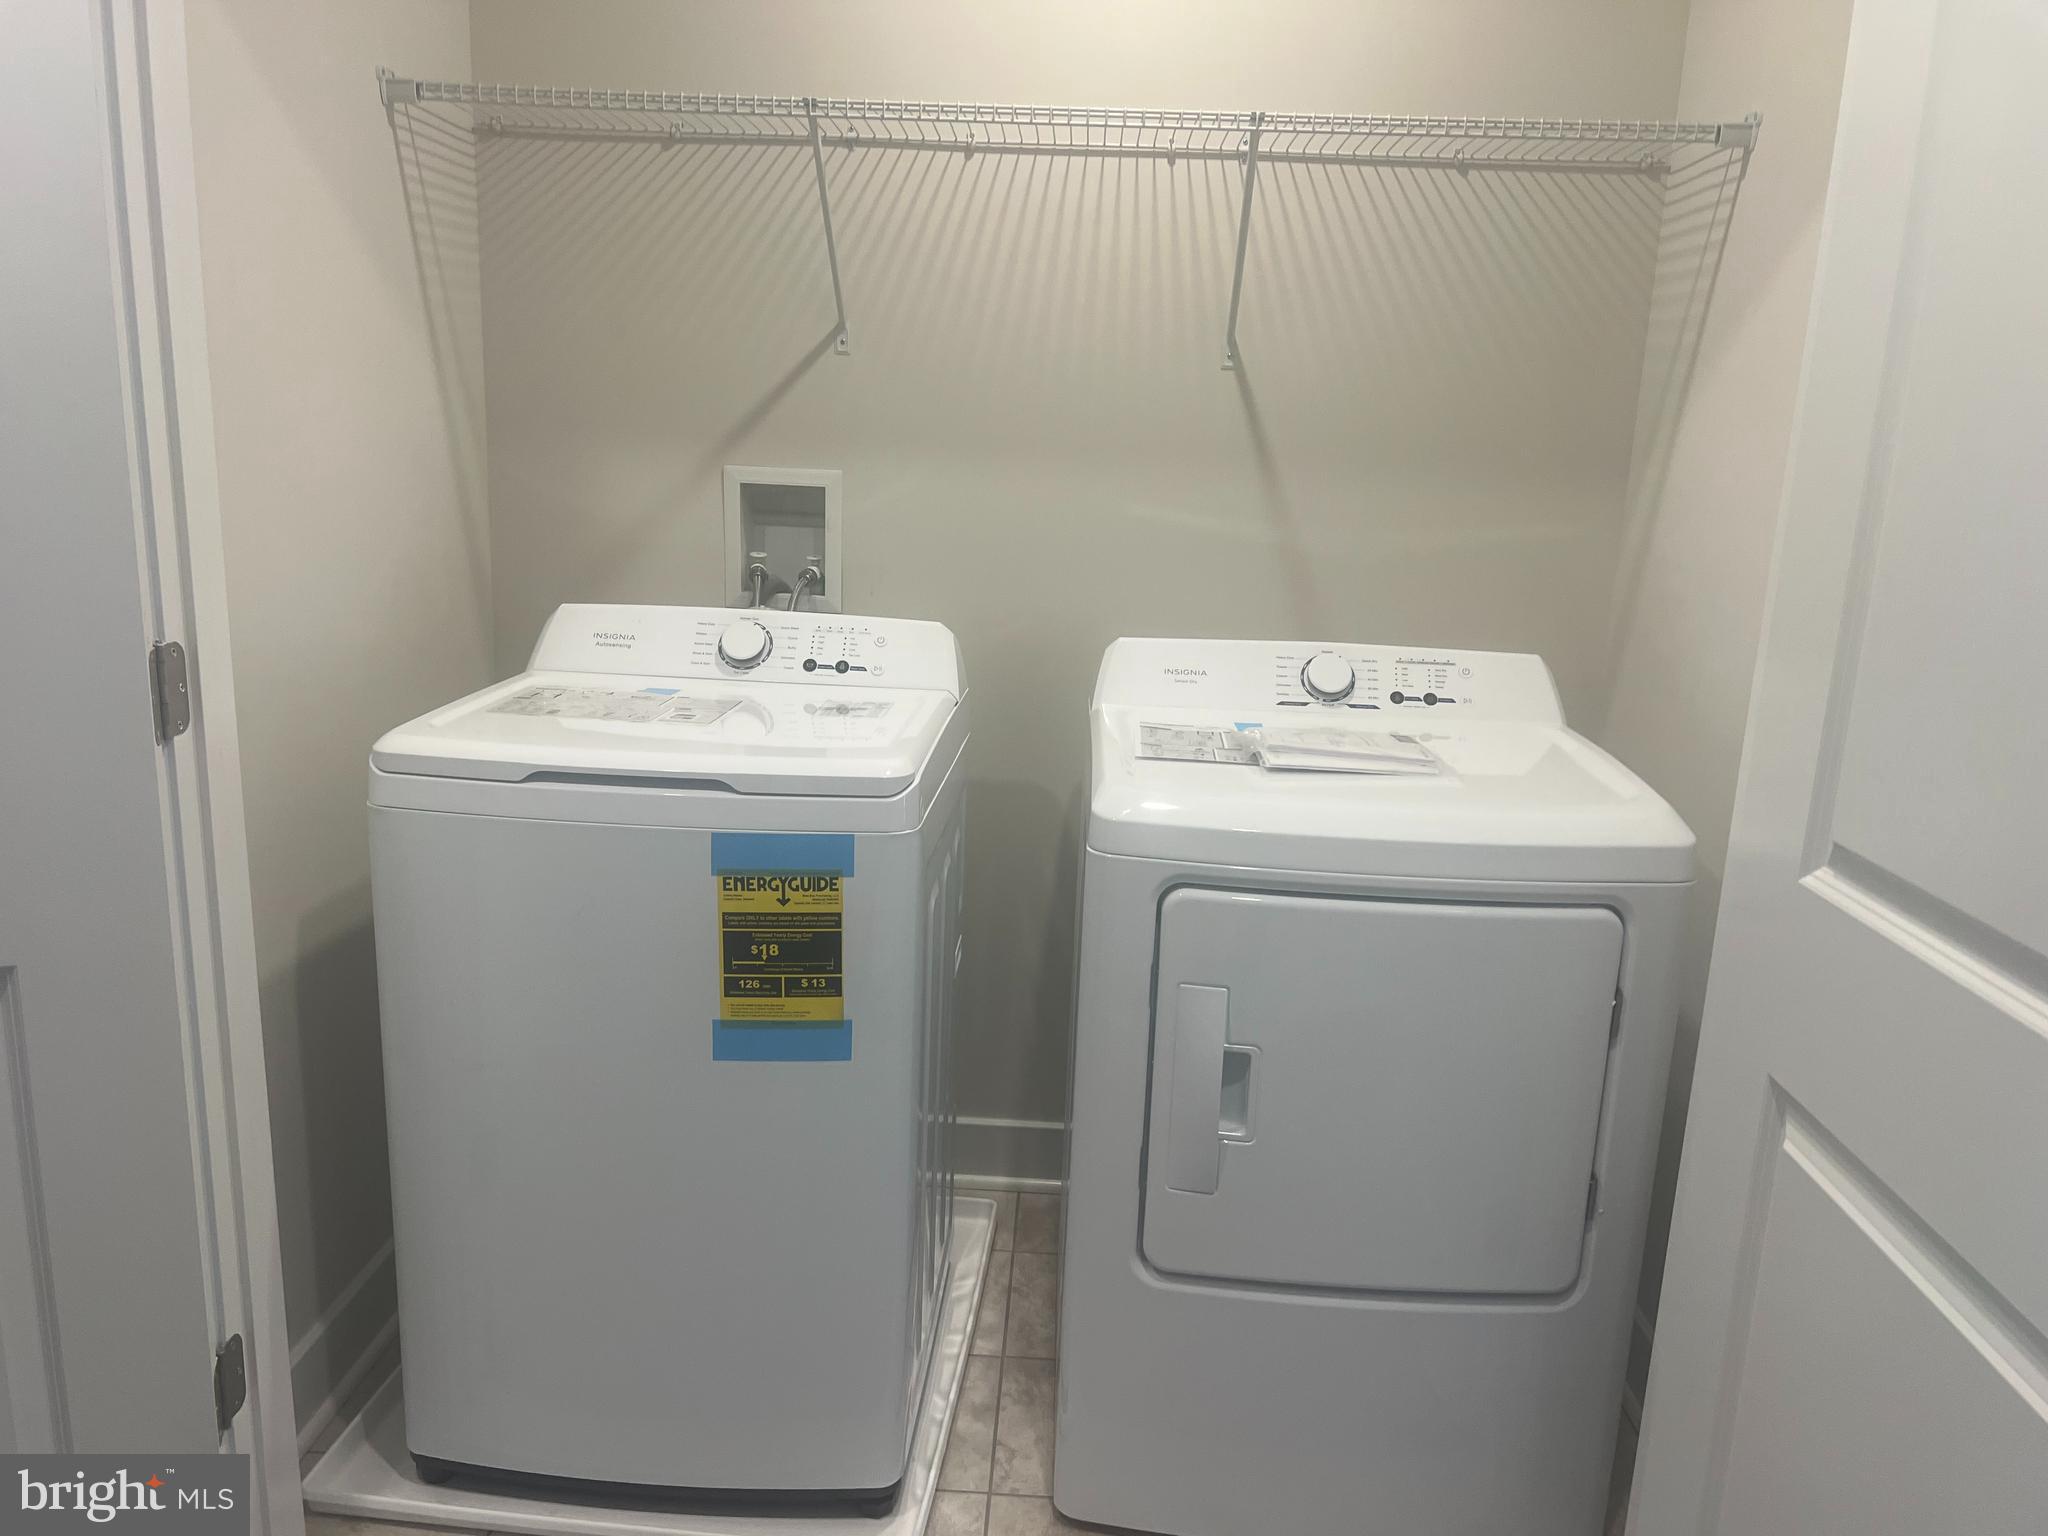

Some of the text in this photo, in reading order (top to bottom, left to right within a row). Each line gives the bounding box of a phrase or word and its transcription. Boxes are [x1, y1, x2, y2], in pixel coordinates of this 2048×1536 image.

[593, 632, 636, 641] INSIGNIA
[595, 641, 632, 649] Autosensing
[1164, 667, 1208, 677] INSIGNIA
[722, 876, 839, 892] ENERGYGUIDE
[751, 943, 779, 956] $18
[738, 979, 760, 989] 126
